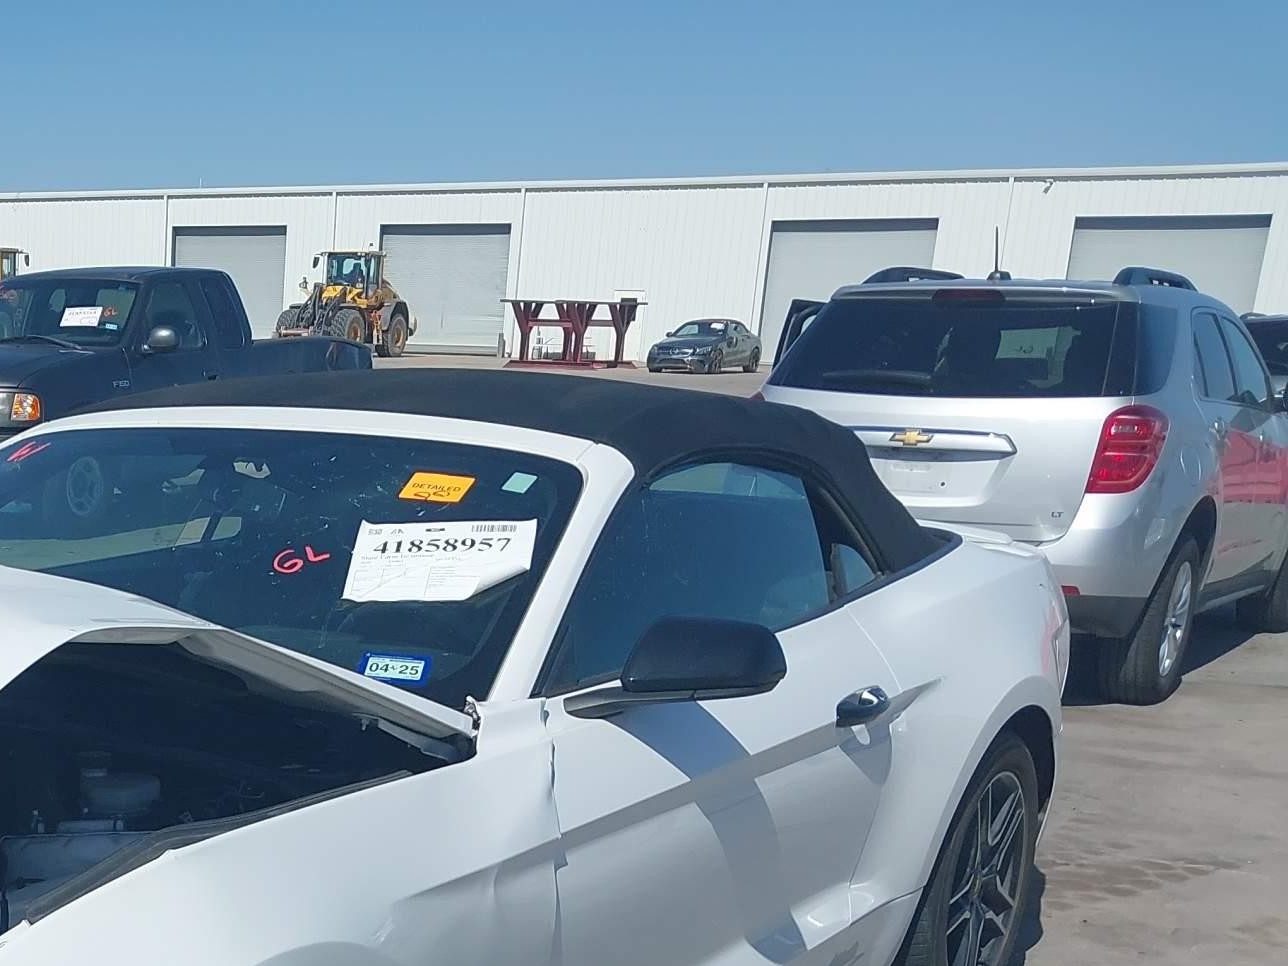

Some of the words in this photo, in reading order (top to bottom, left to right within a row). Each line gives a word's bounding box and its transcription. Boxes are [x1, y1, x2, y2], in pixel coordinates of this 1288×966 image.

[412, 482, 462, 493] DETAILED
[373, 538, 512, 554] 41858957
[273, 546, 330, 573] GL
[369, 662, 389, 673] 04
[398, 664, 420, 676] 25
